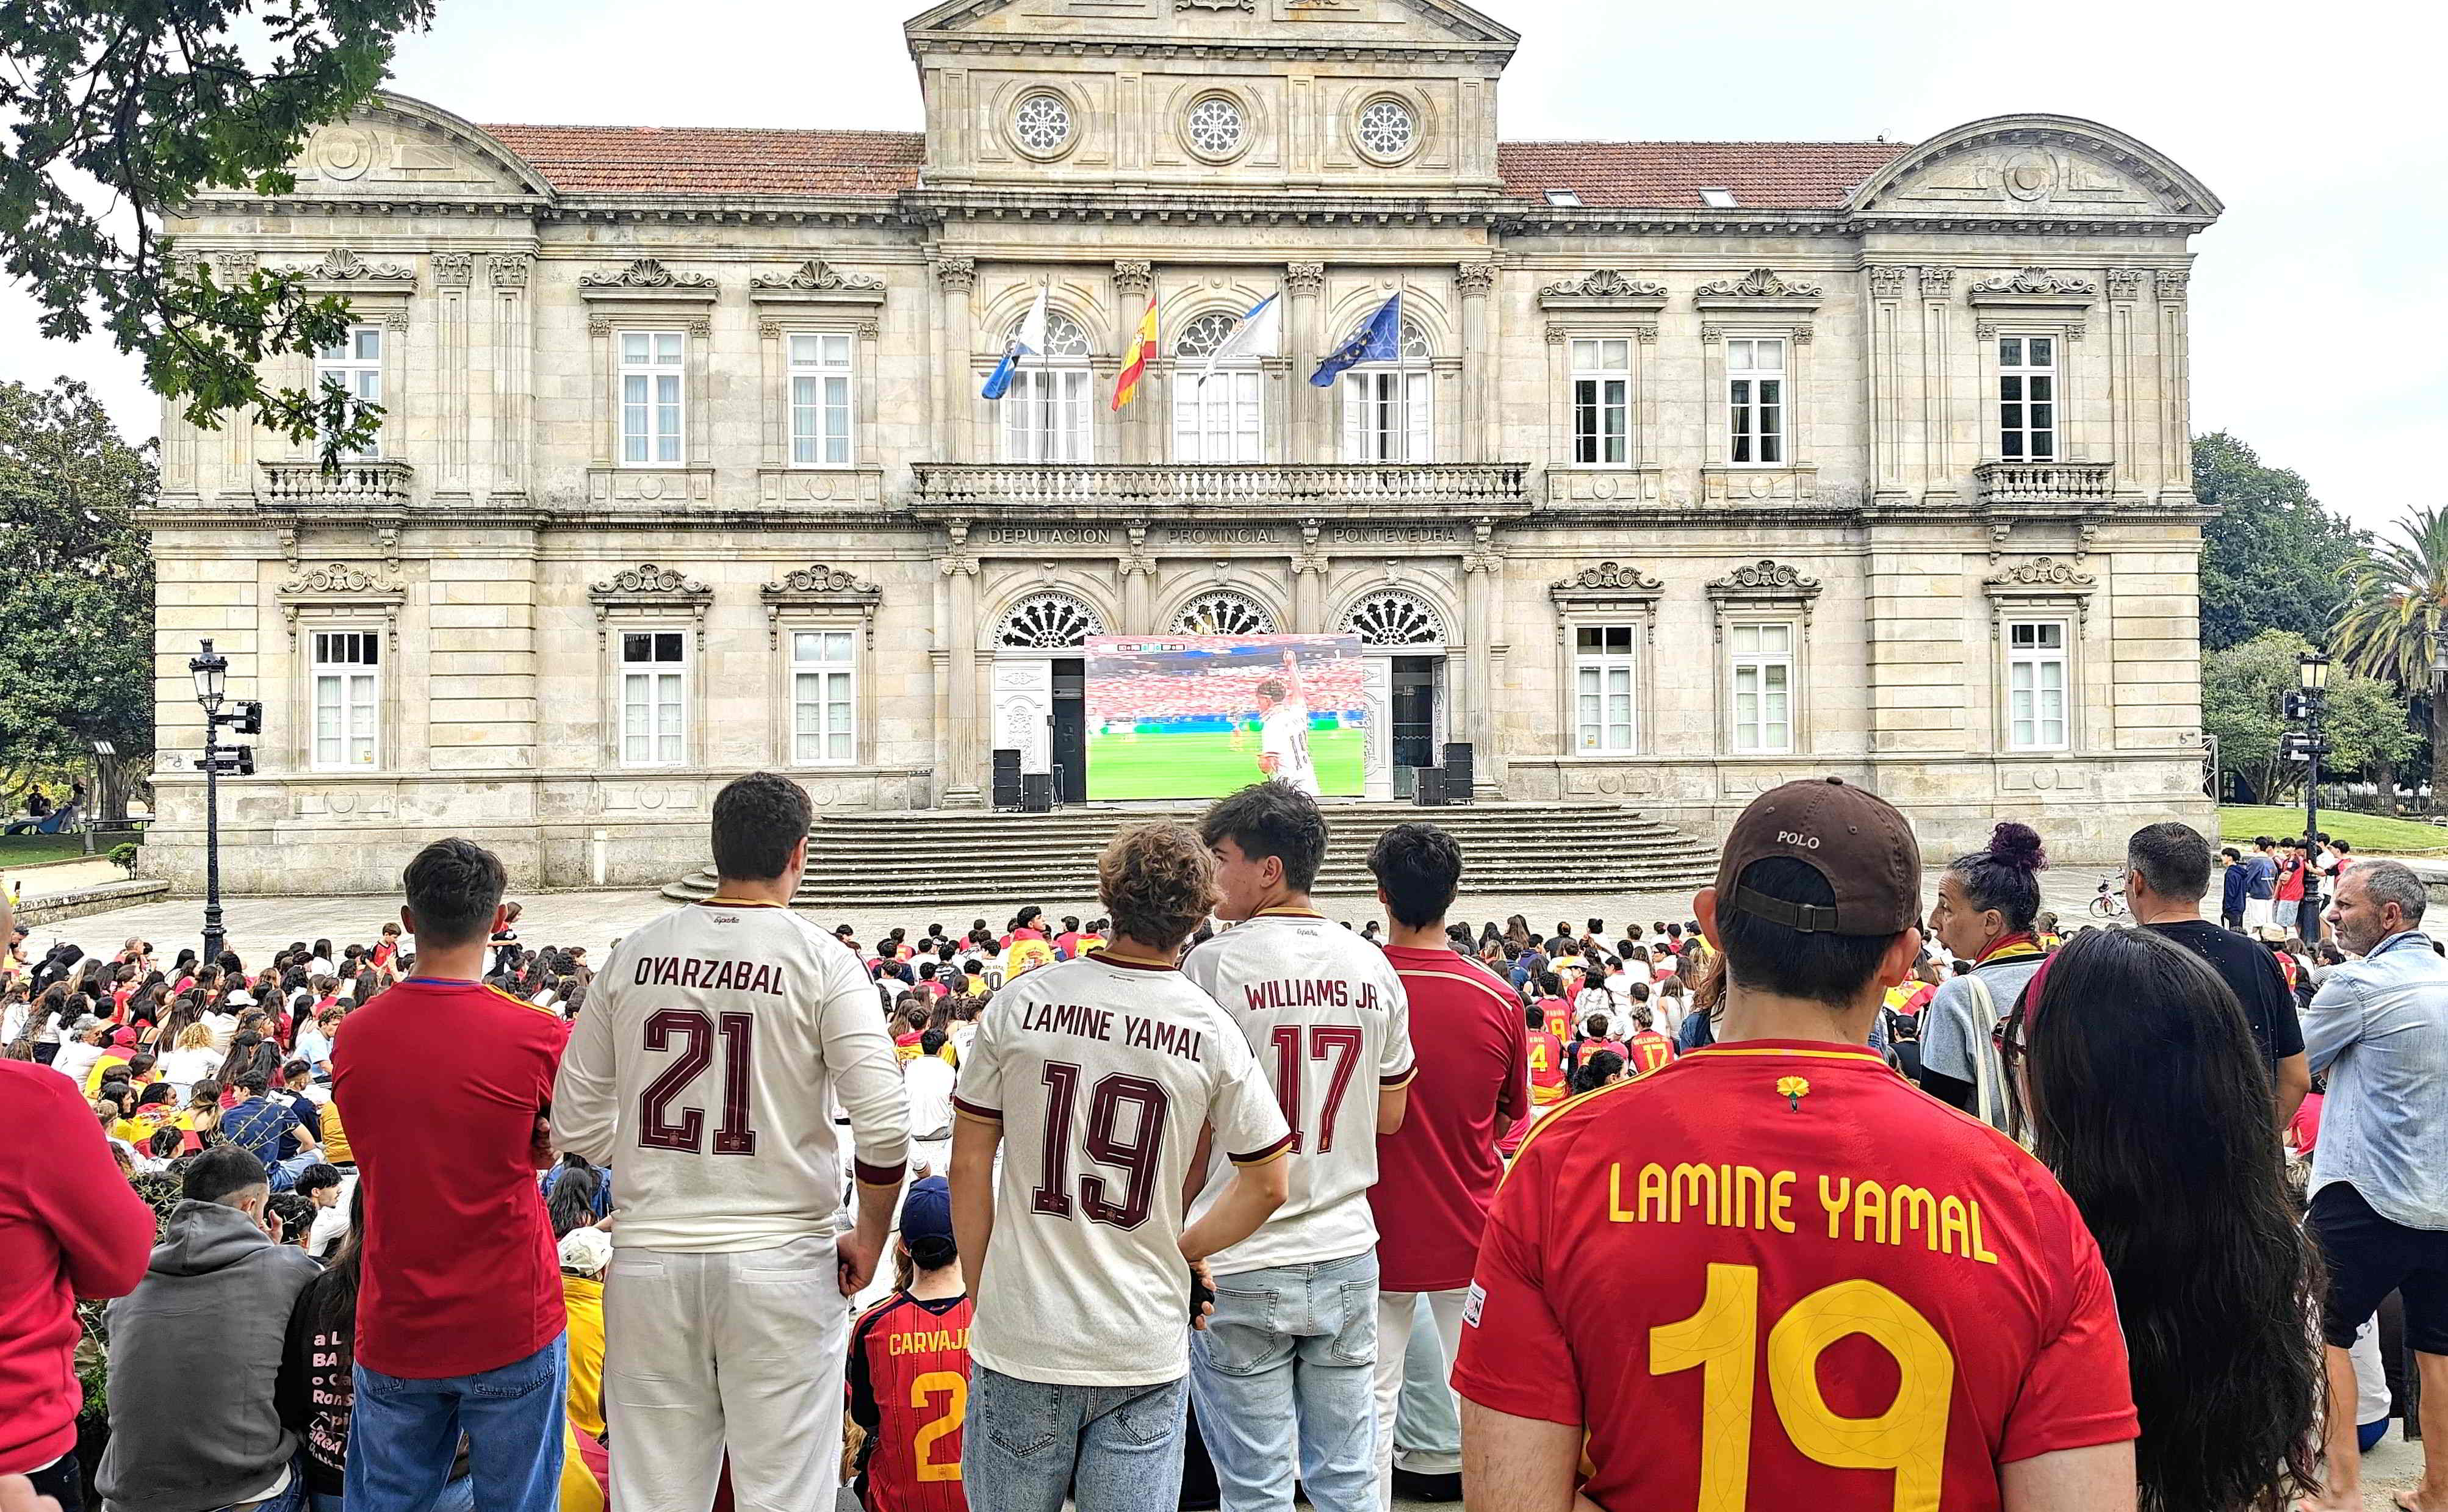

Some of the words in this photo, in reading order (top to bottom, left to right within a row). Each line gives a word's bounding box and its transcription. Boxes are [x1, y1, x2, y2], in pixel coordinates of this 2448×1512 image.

[987, 528, 1111, 544] DEPUTACION
[1167, 528, 1280, 544] PROVINCIAL
[1333, 528, 1458, 542] PONTEVEDRA
[1776, 830, 1821, 850] POLO
[634, 957, 784, 996] OYARZABAL
[1245, 979, 1348, 1010] WILLIAMS
[1355, 982, 1383, 1011] JR.
[1022, 1002, 1114, 1041] LAMINE
[1125, 1015, 1202, 1063] YAMAL
[1530, 1044, 1548, 1071] 4
[638, 1008, 756, 1156] 21
[1271, 1024, 1364, 1155] 17
[1031, 1060, 1171, 1233] 19
[1607, 1162, 1796, 1233] LAMINE
[1818, 1175, 1999, 1265] YAMAL
[911, 1371, 968, 1482] 2
[1649, 1262, 1954, 1512] 19
